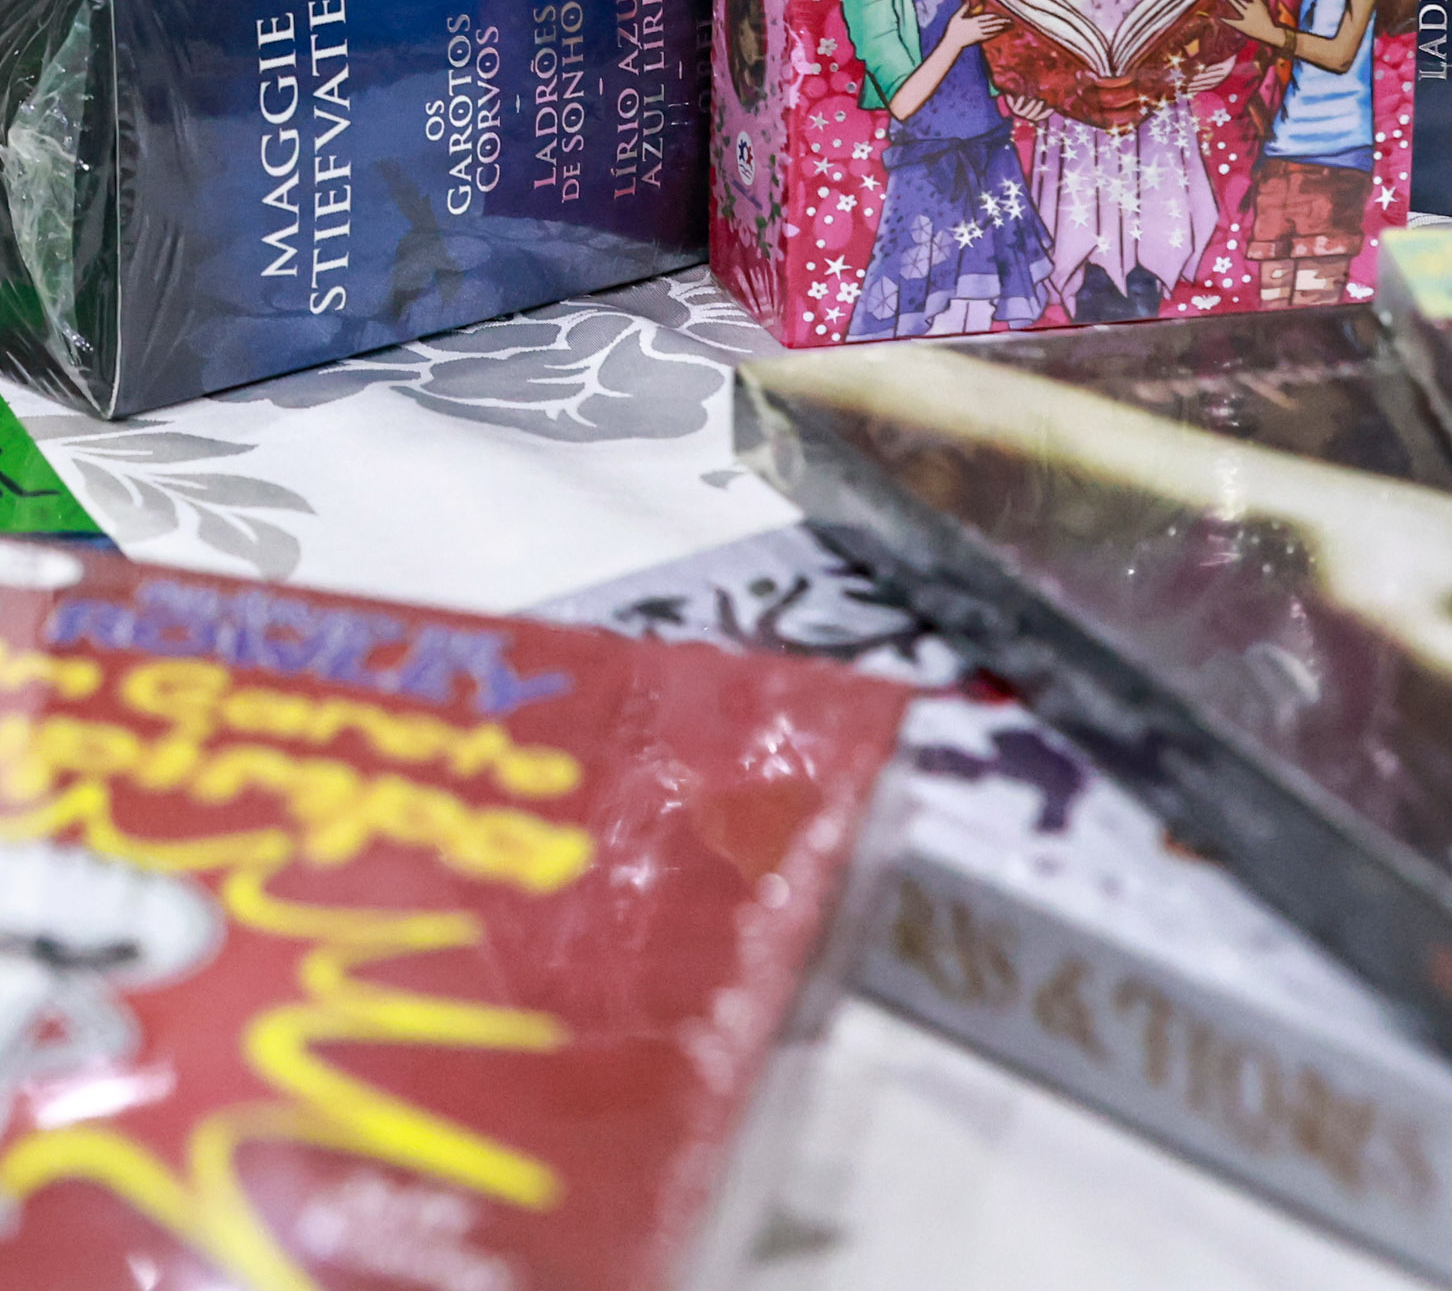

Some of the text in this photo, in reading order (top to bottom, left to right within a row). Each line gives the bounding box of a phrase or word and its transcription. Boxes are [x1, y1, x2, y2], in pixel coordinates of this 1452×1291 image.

[257, 12, 300, 277] MAGGIE
[426, 99, 444, 142] OS
[447, 14, 473, 216] GAROTOS
[476, 25, 501, 192] CORVOS
[530, 4, 558, 190] LADRÕES
[611, 88, 640, 200] LÍRIO
[640, 84, 665, 188] AZUL
[562, 162, 580, 203] DE
